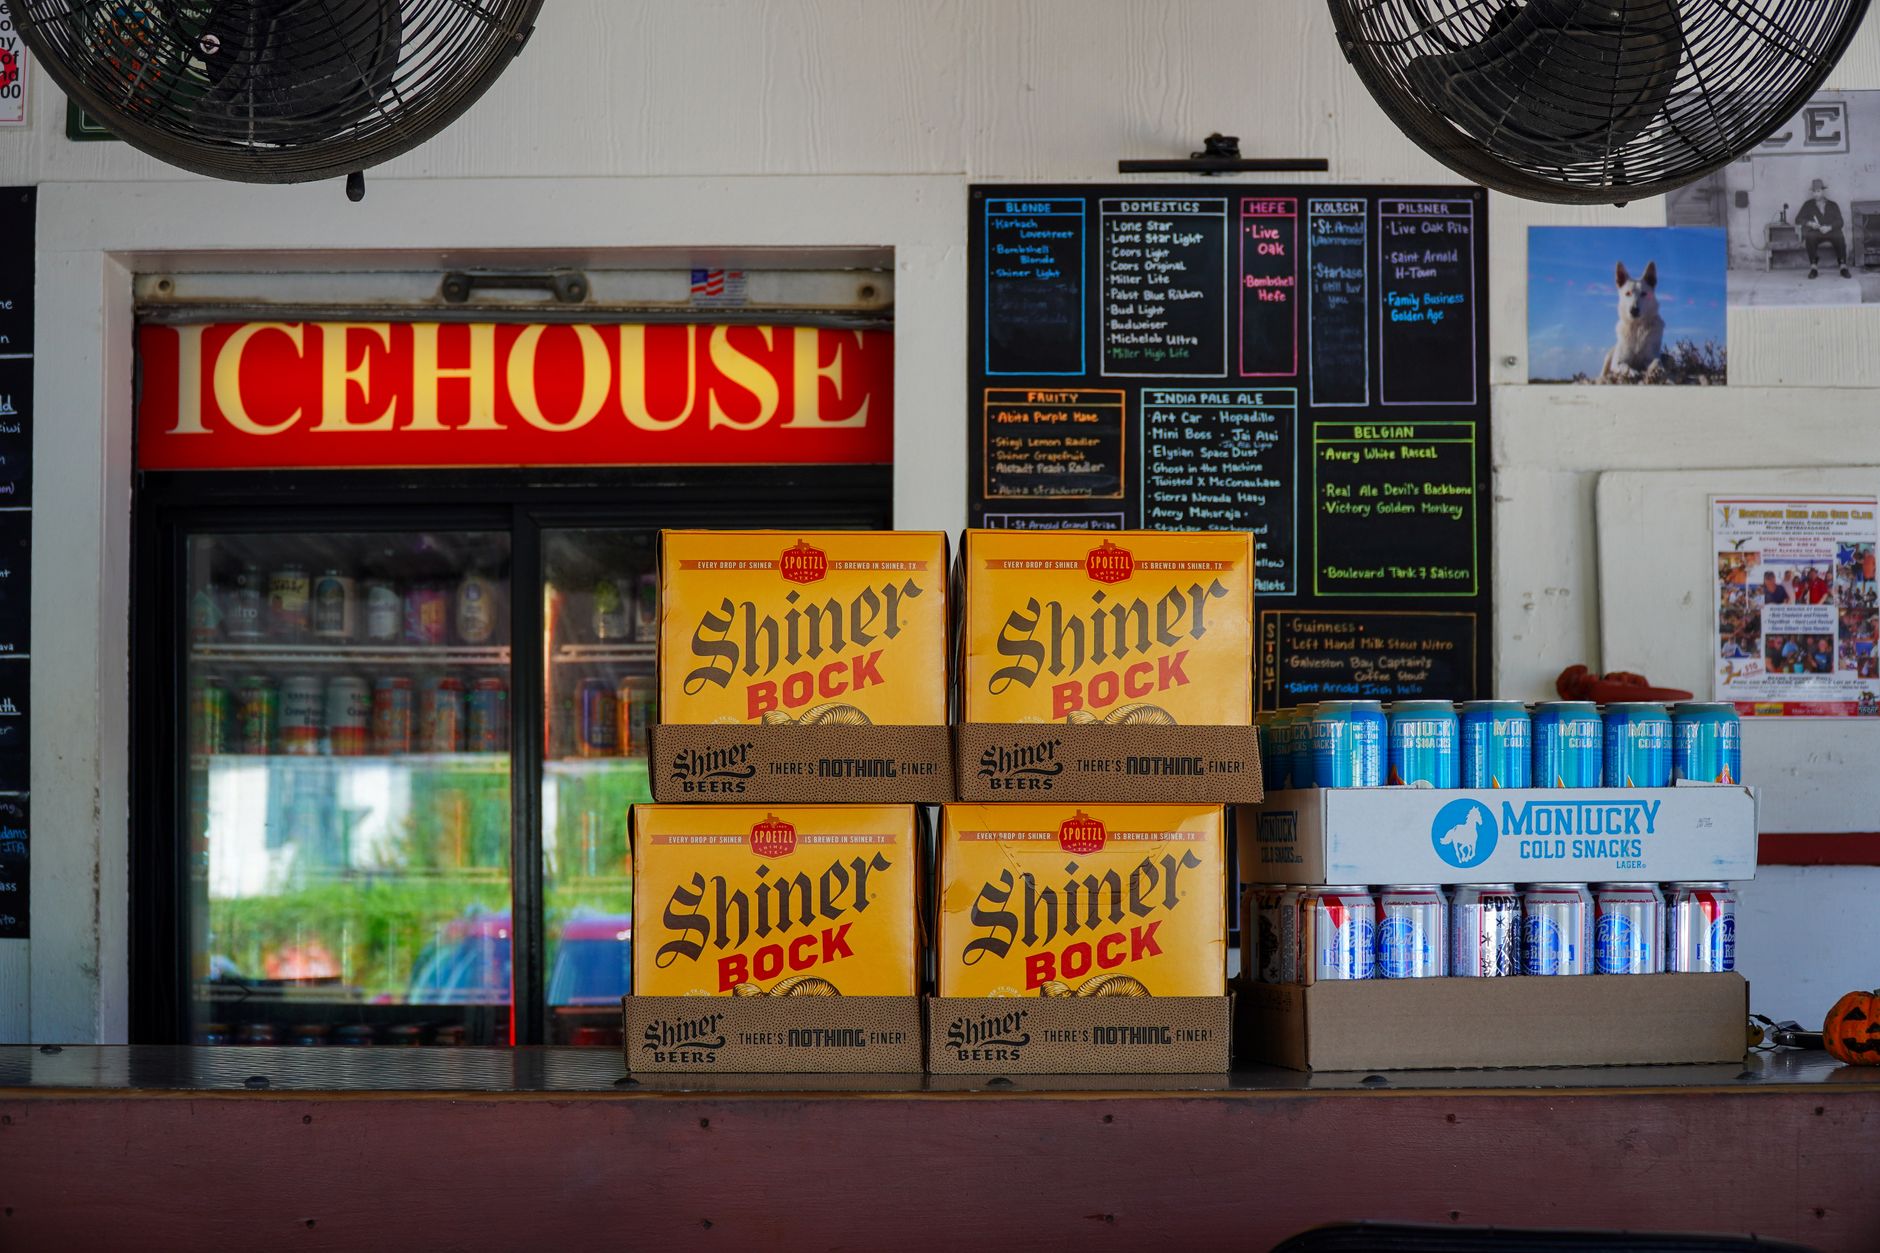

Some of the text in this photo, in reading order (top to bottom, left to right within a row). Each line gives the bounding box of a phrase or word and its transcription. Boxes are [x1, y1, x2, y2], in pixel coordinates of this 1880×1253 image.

[1006, 202, 1051, 213] BLONDE
[1120, 201, 1200, 213] DOMESTICS
[1250, 202, 1286, 213] HEFE
[1315, 202, 1359, 213] KOLSCH
[1398, 203, 1450, 214] PILSNER
[1112, 220, 1173, 232] Lone Star
[1252, 224, 1279, 239] Live
[1391, 221, 1416, 236] Live
[1421, 221, 1444, 234] Oak
[1111, 233, 1204, 247] Lone Star Light
[1112, 247, 1170, 262] Coors Light
[1258, 242, 1285, 256] Oak
[1391, 249, 1458, 264] Saint Arnold
[1110, 260, 1139, 271] Coors
[1395, 266, 1437, 279] H-Town
[1110, 273, 1170, 285] Miller Lite
[1110, 287, 1204, 300] Pabst Blue Ribbon
[1258, 288, 1286, 302] Hefe
[1388, 291, 1464, 311] Family Business
[1110, 303, 1165, 318] Bud Light
[1391, 308, 1444, 325] Golden Age
[1110, 319, 1168, 330] Budweiser
[1110, 333, 1198, 346] Michelob Ultra
[1112, 347, 1190, 361] Miller High Life
[165, 322, 870, 435] ICEHOUSE
[1027, 392, 1079, 404] FRUITY
[1153, 393, 1264, 405] INDIA PALE ALE
[997, 411, 1029, 423] Abita
[1033, 411, 1068, 424] Purple
[1151, 411, 1202, 423] Art Car
[1219, 410, 1275, 425] Hopadillo
[1152, 427, 1212, 440] Mini Boss
[1231, 428, 1279, 441] Jai Alai
[1354, 426, 1414, 439] BELGIAN
[1028, 437, 1061, 448] Lemon
[1152, 445, 1258, 460] Elysian Space Dust
[1325, 446, 1438, 464] Avery White Rascal
[1153, 461, 1263, 473] Ghost in the Machine
[1152, 475, 1193, 486] Twisted
[1197, 476, 1206, 486] X
[1326, 482, 1473, 497] Real Ale Devil's Backbone
[1154, 491, 1187, 502] Sierra
[1192, 492, 1232, 503] Nevada
[1152, 506, 1241, 520] Avery Maharaja
[1326, 501, 1463, 520] Victory Golden Monkey
[698, 561, 772, 570] EVERY DROP OF SHINER
[784, 555, 824, 571] SPOETZL
[835, 562, 842, 571] IS
[845, 562, 870, 571] BREWED
[872, 562, 879, 571] IN
[909, 562, 917, 571] TX
[1090, 555, 1130, 570] SPOETZL
[1327, 566, 1470, 579] Boulevard Tank 7 Saison
[1293, 618, 1355, 633] Guinness
[683, 578, 924, 696] Shiner
[988, 578, 1230, 695] Shiner
[1292, 637, 1453, 650] Left Hand Milk Stout Nitro
[1291, 655, 1344, 669] Galveston
[1350, 656, 1374, 671] Bay
[1354, 670, 1391, 682] Coffee
[746, 649, 886, 721] BOCK
[1052, 650, 1190, 720] BOCK
[670, 741, 756, 784] Shiner
[977, 738, 1063, 778] Shiner
[769, 758, 938, 778] THERE'S NOTHING FINER!
[1077, 756, 1245, 776] THERE'S NOTHING FINER!
[683, 781, 746, 794] BEERS
[990, 778, 1053, 790] BEERS
[1501, 800, 1661, 836] MONTUCKY
[754, 830, 793, 844] SPOETZL
[1063, 827, 1103, 841] SPOETZL
[1520, 839, 1642, 859] COLD SNACKS
[1616, 861, 1641, 869] LAGER
[655, 851, 892, 968] Shiner
[962, 848, 1202, 966] Shiner
[718, 922, 855, 993] BOCK
[1025, 920, 1163, 991] BOCK
[642, 1012, 725, 1052] Shiner
[944, 1008, 1031, 1050] Shiner
[1044, 1026, 1213, 1045] THERE'S NOTHING FINER!
[739, 1029, 907, 1048] THERE'S NOTHING FINER!
[655, 1051, 716, 1063] BEERS
[958, 1049, 1020, 1061] BEERS
